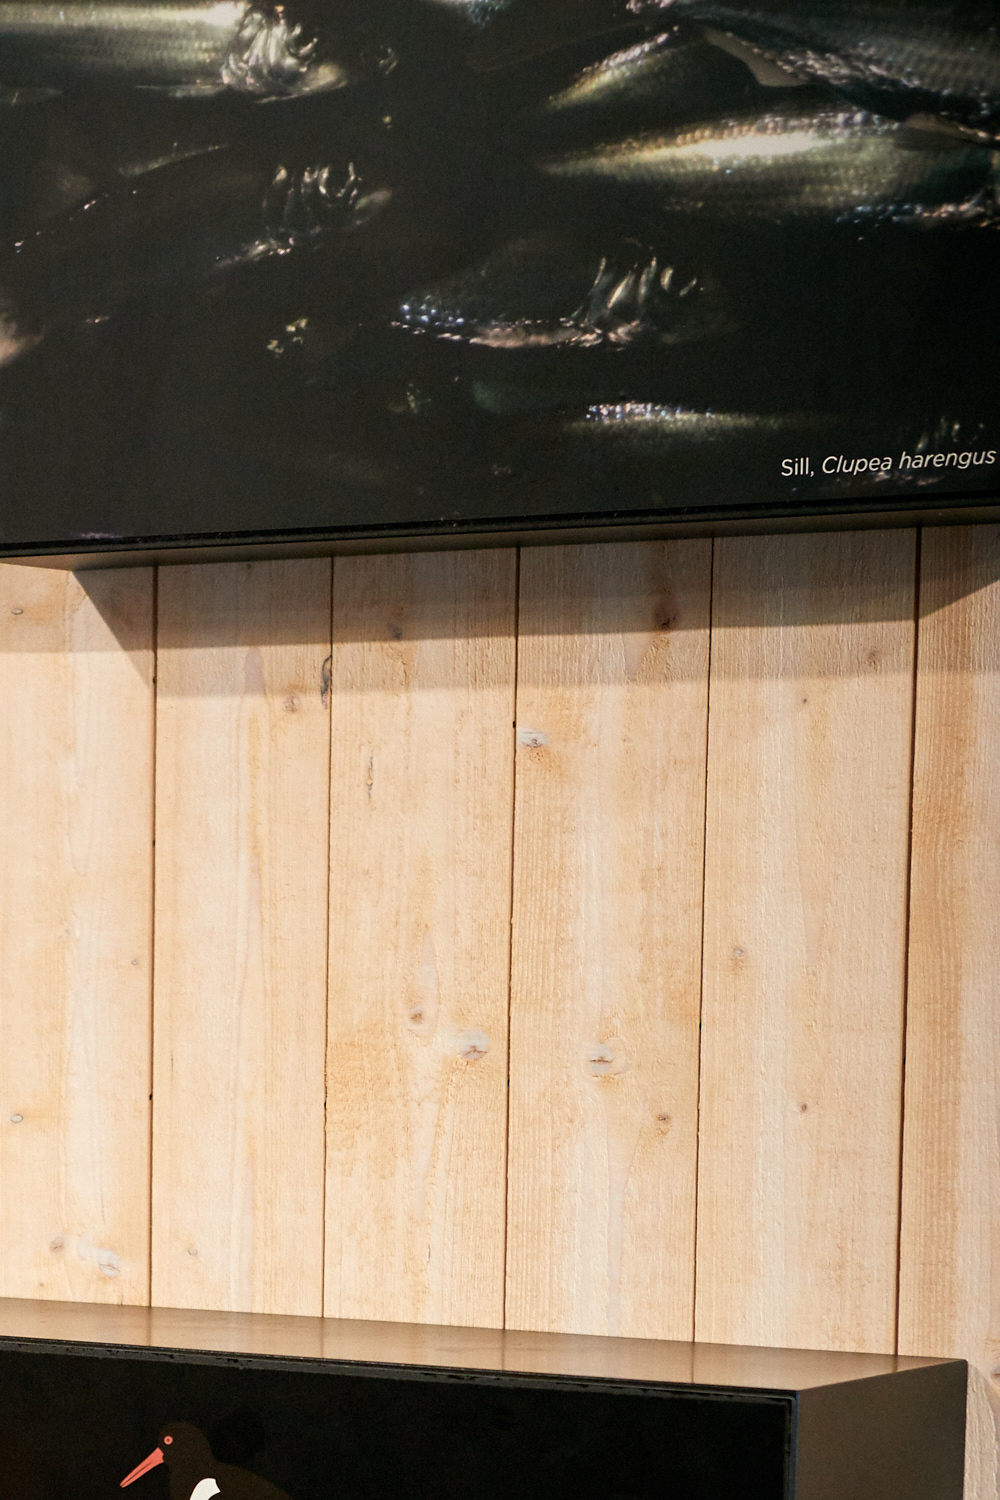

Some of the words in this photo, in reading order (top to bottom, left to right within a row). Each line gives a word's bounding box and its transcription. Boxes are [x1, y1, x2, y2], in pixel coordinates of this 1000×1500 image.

[780, 457, 815, 478] Sill,
[821, 454, 892, 476] Clupea
[898, 450, 997, 470] harengus
